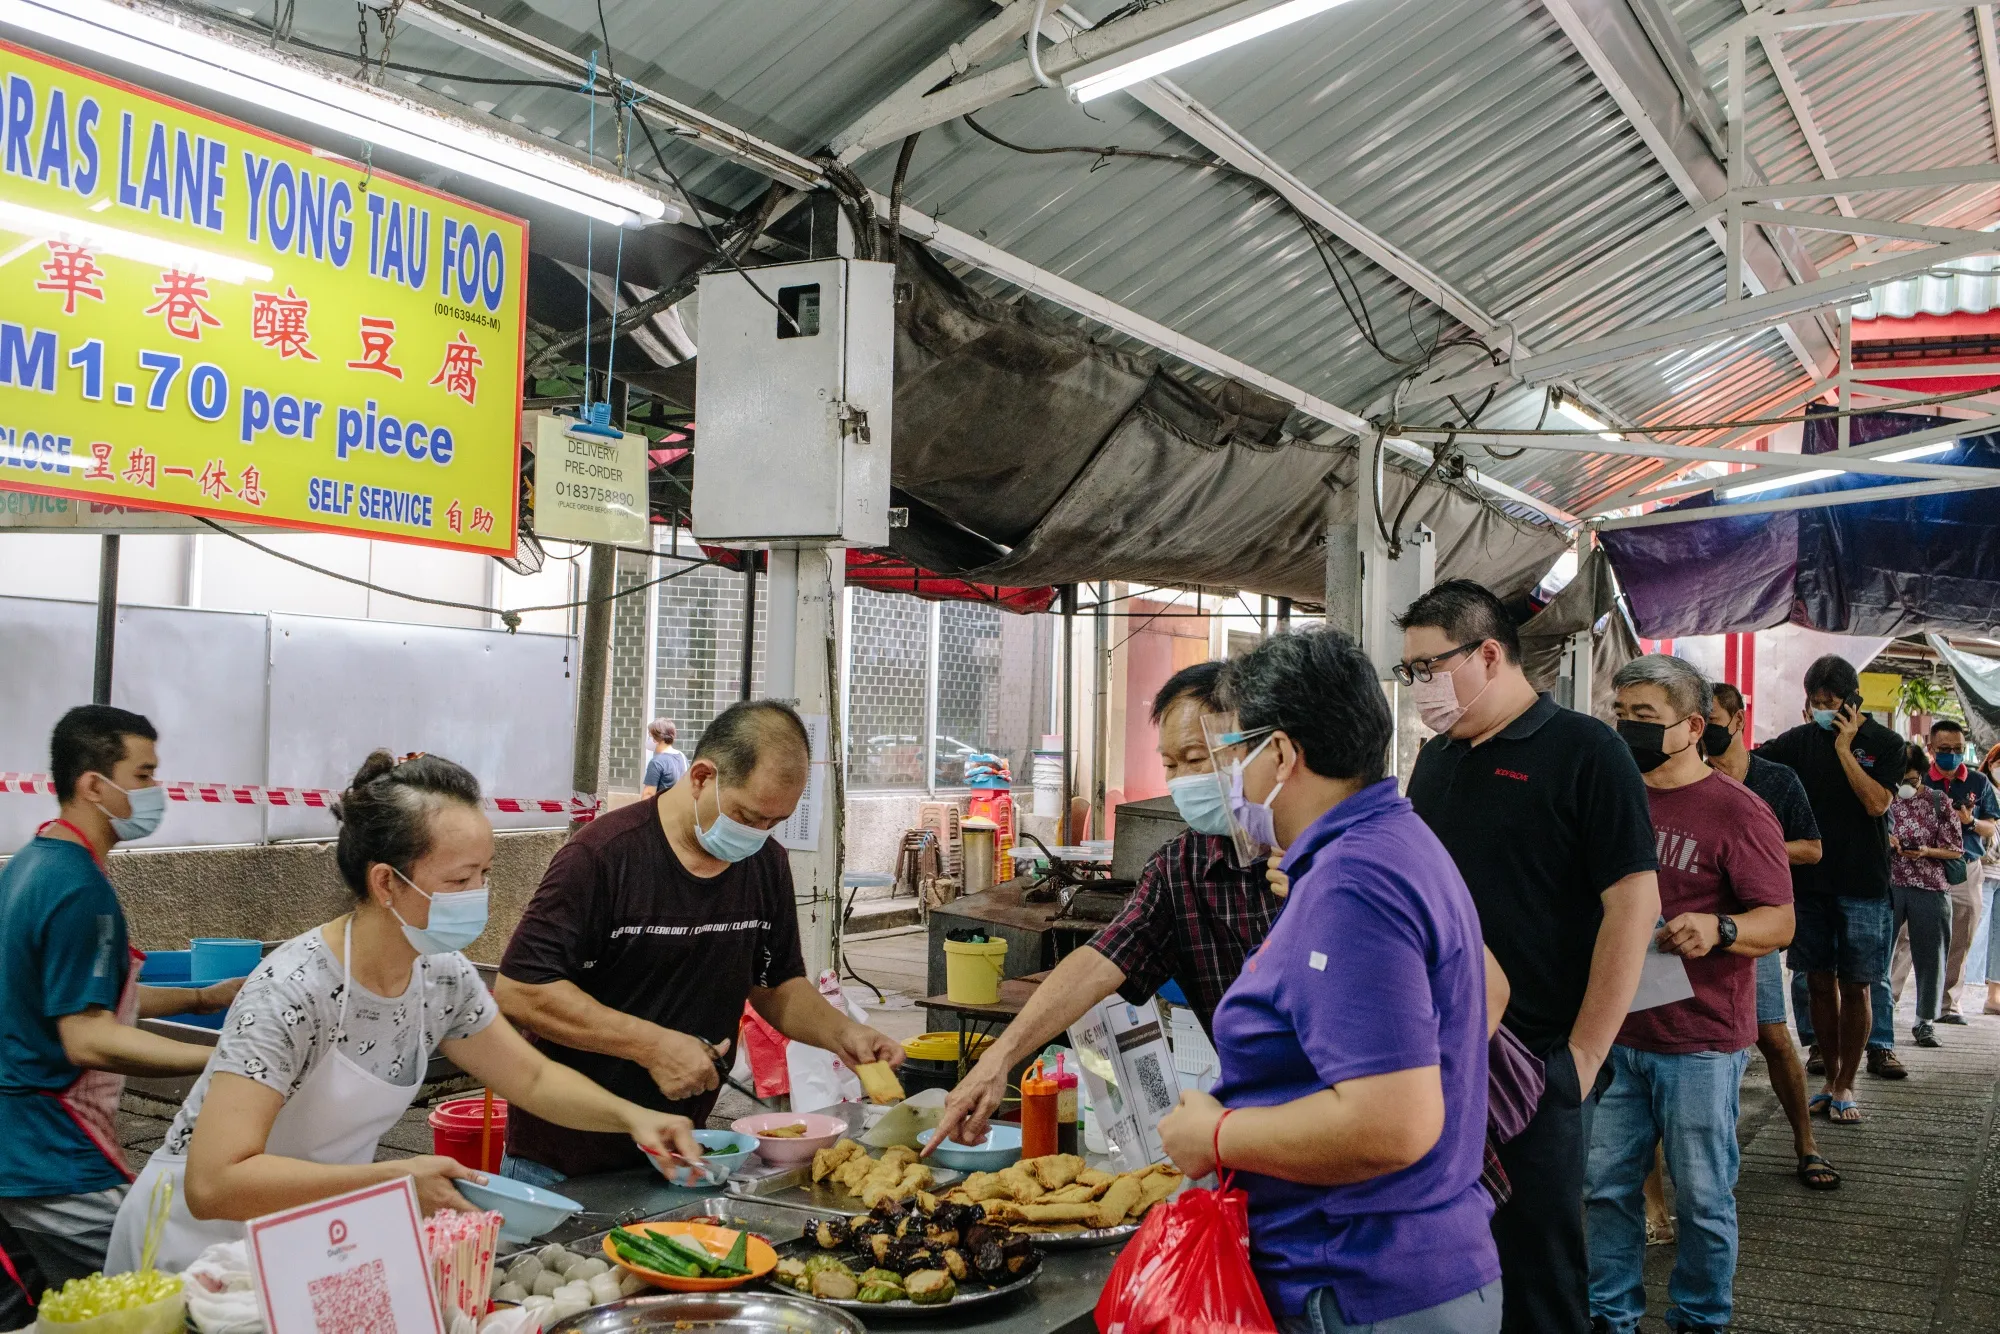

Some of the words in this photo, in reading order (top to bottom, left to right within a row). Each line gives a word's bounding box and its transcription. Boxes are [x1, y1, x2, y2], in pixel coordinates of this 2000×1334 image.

[0, 75, 100, 195] RAS
[119, 113, 226, 231] LANE
[244, 152, 353, 267] YONG
[368, 193, 429, 289] TAU
[442, 219, 504, 310] FOO
[434, 302, 501, 333] (001639445-M)
[241, 388, 322, 442] per
[337, 400, 453, 464] piece
[86, 443, 265, 506] 星期一休息
[565, 460, 623, 482] PRE-ORDER
[309, 478, 354, 514] SELF
[359, 486, 432, 527] SERVICE
[556, 481, 635, 507] 0183758890
[446, 500, 494, 534] 自助
[671, 927, 689, 935] OUT
